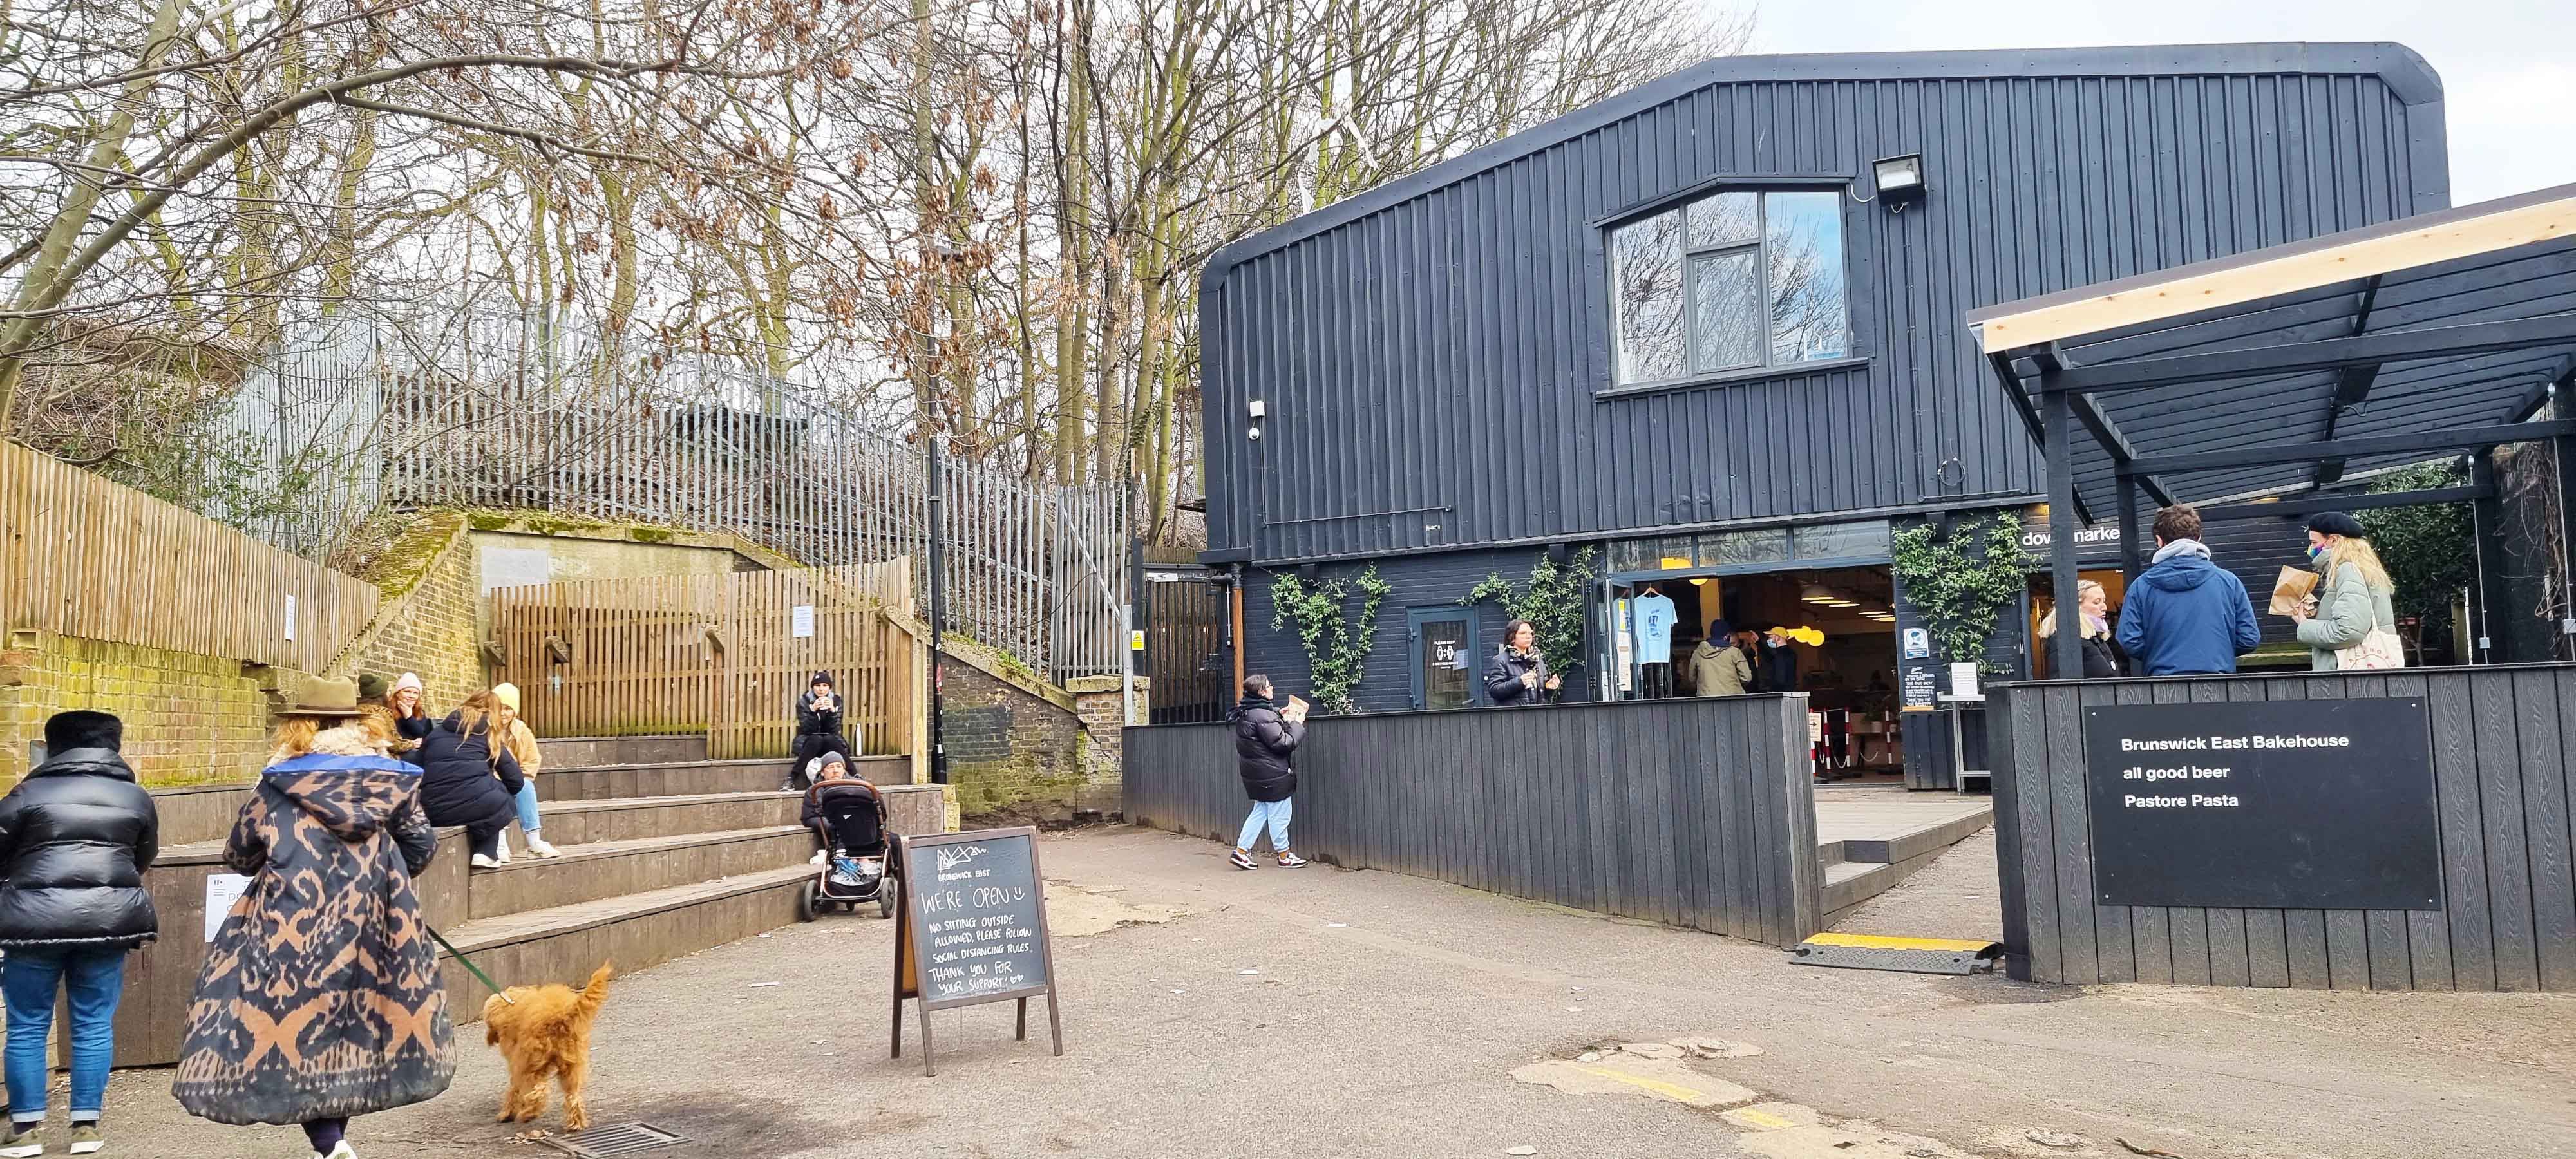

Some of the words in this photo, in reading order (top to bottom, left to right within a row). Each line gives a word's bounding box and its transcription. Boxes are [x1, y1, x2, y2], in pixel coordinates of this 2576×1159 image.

[2121, 737, 2207, 751] Brunswick
[2211, 736, 2249, 749] East
[2253, 735, 2349, 749] Bakehouse
[2123, 767, 2142, 779] all
[2146, 766, 2188, 782] good
[2192, 766, 2230, 778] beer
[2125, 795, 2187, 807] Pastore
[2192, 794, 2239, 807] Pasta
[975, 869, 990, 878] EAST
[921, 889, 963, 914] WE'RE
[973, 887, 1009, 908] OPEN
[929, 923, 941, 934] NO
[944, 918, 976, 931] SITTING
[981, 914, 1014, 927] OUTSIDE
[976, 928, 1001, 941] PLEASE
[1005, 927, 1032, 939] FOLLOW
[933, 952, 958, 964] SOCIAL
[961, 944, 1004, 959] DISTANCING
[928, 966, 965, 982] THANK
[970, 963, 987, 977] YOU
[994, 961, 1012, 974] FOR
[938, 981, 963, 995] YOUR
